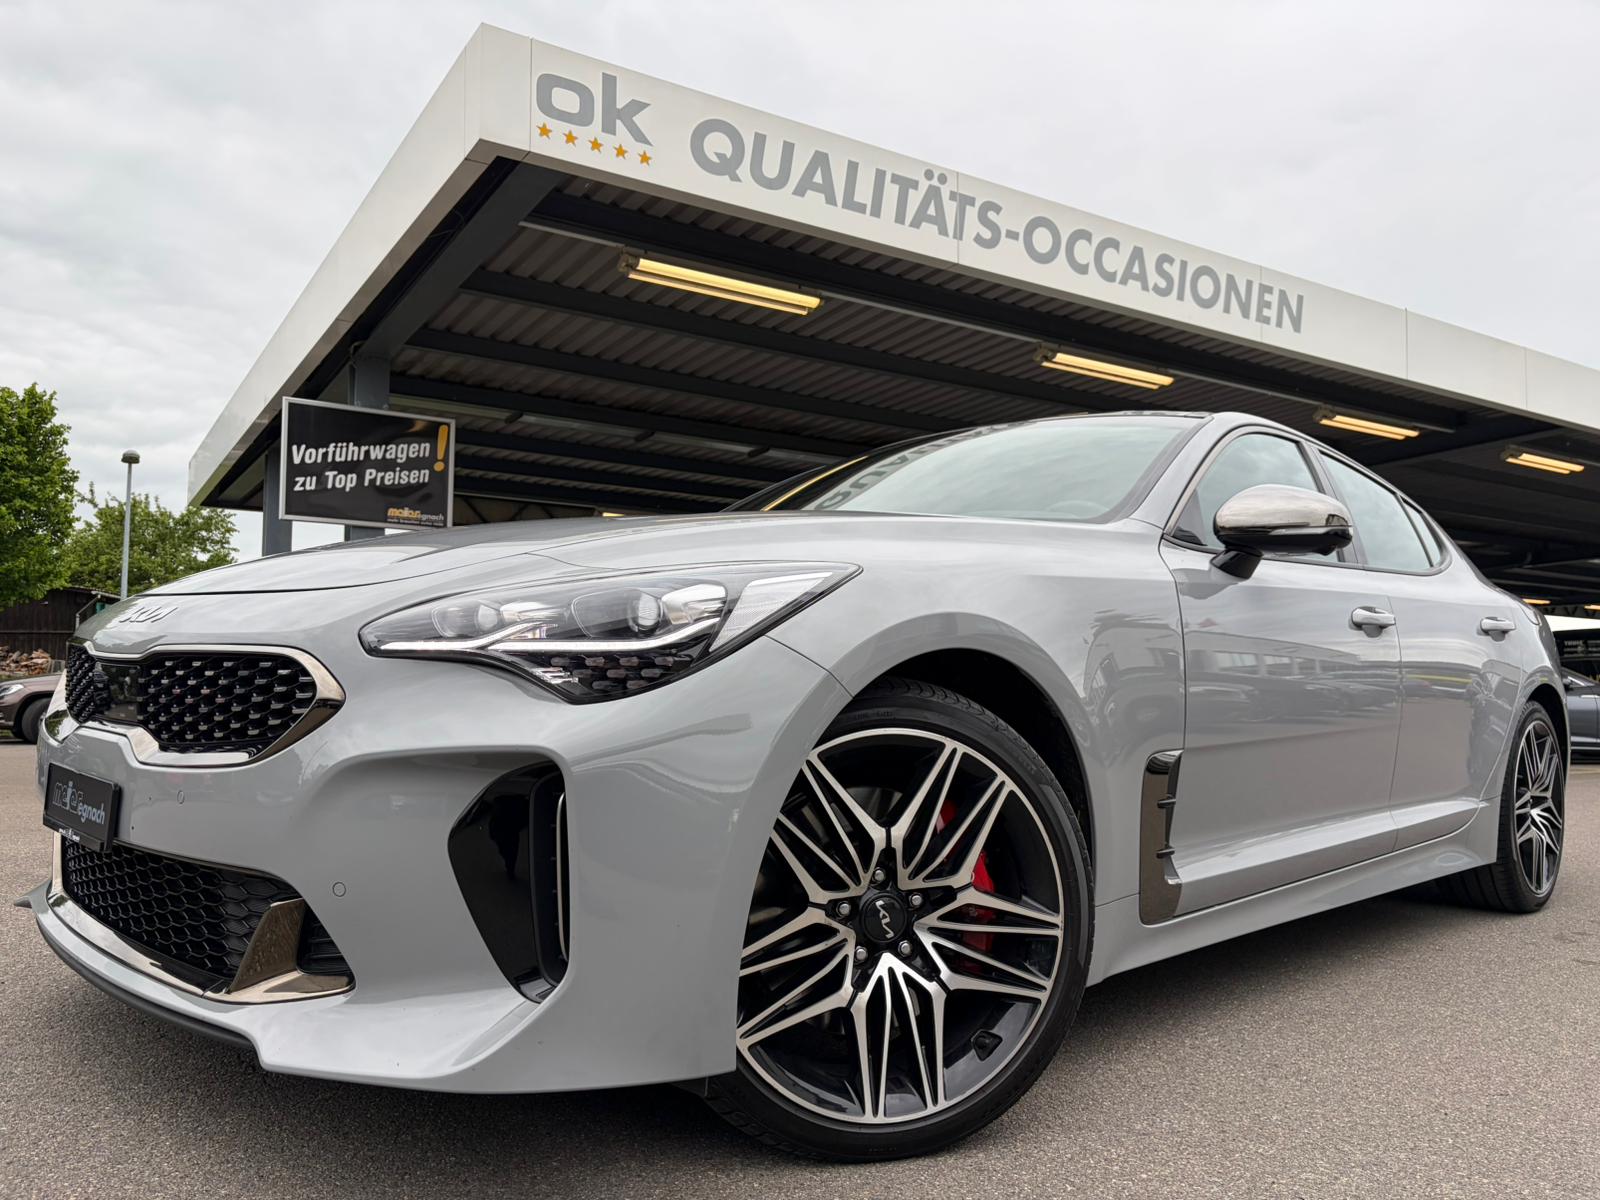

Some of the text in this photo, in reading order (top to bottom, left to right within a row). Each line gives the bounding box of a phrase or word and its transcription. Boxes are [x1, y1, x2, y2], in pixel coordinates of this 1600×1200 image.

[536, 72, 654, 147] ok
[690, 117, 1304, 334] QUALITÄTS-OCCASIONEN
[291, 442, 431, 464] Vorführwagen
[293, 467, 430, 492] zu Top Preisen
